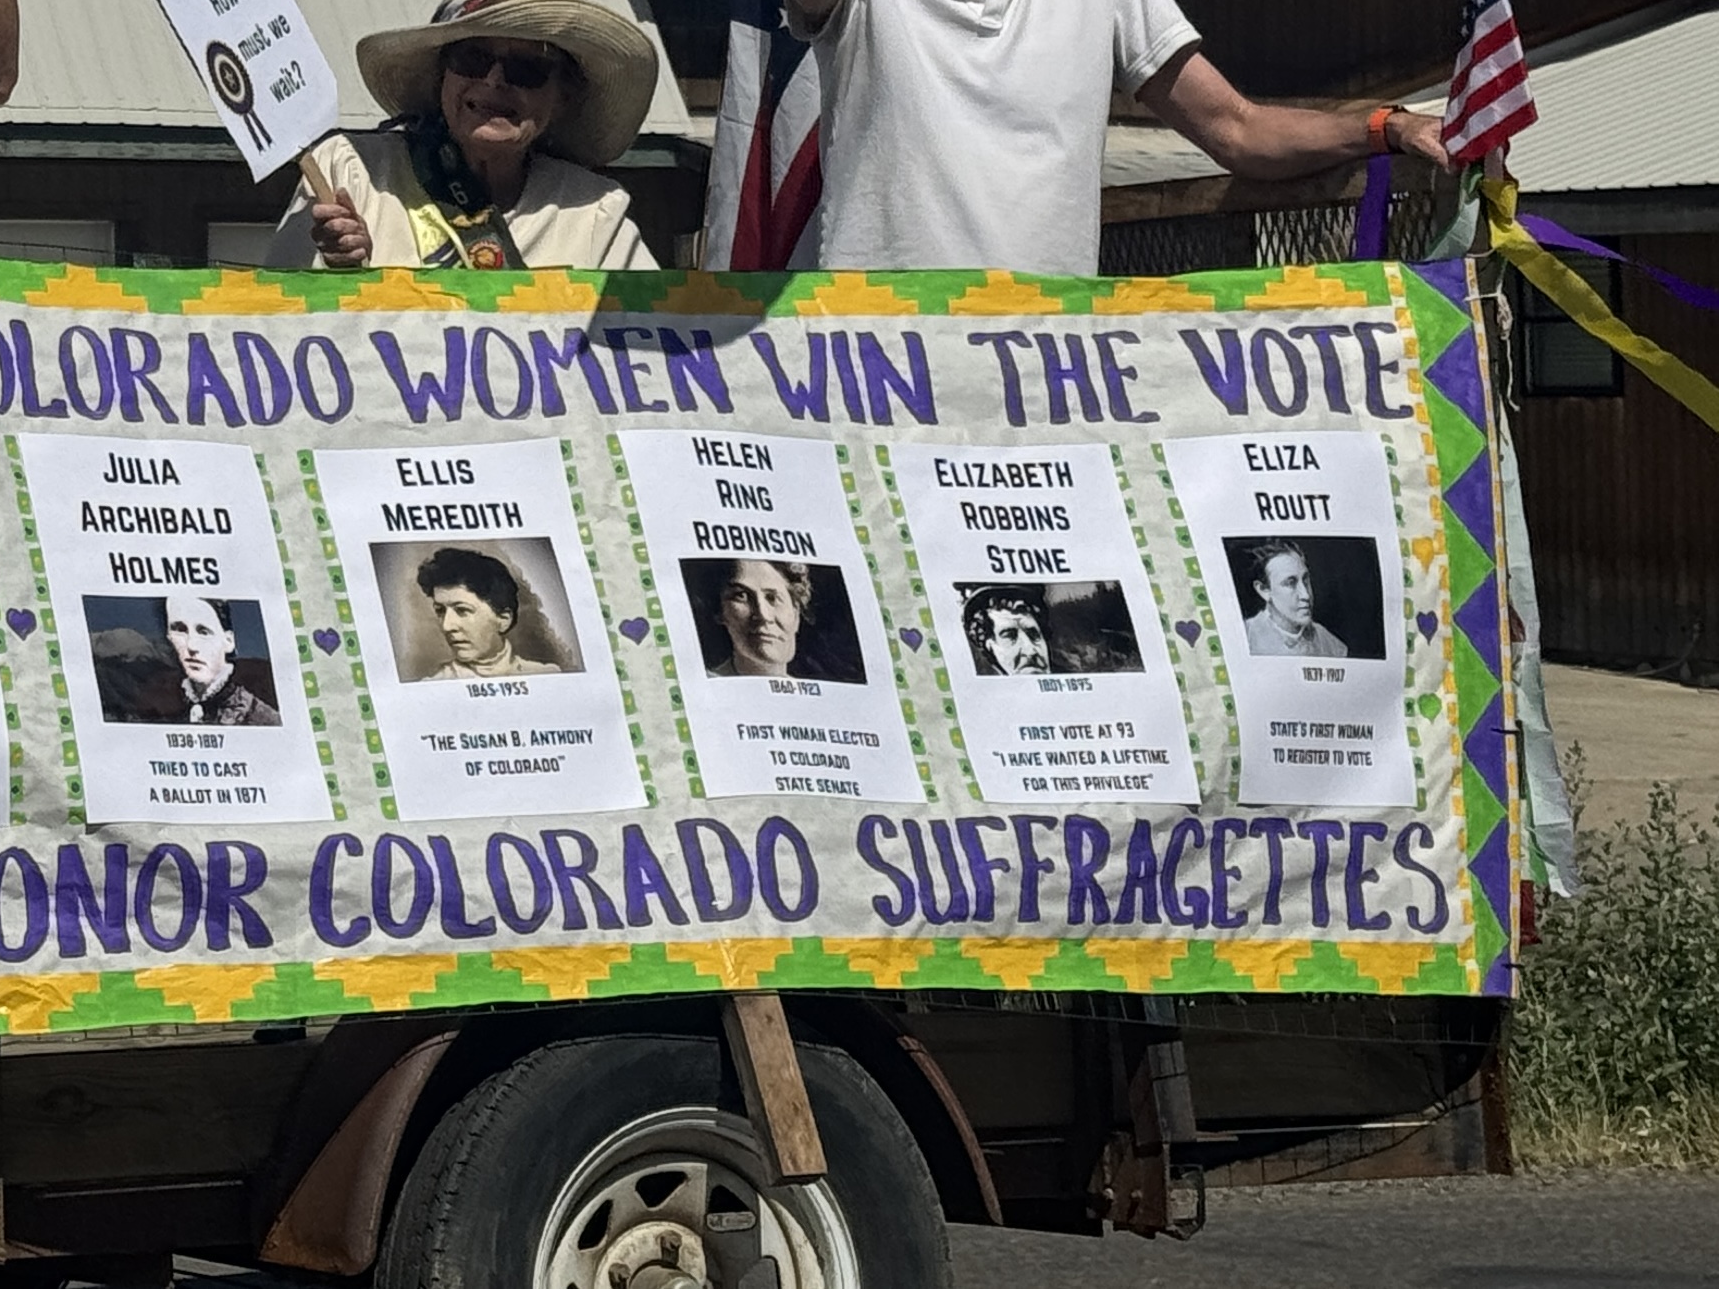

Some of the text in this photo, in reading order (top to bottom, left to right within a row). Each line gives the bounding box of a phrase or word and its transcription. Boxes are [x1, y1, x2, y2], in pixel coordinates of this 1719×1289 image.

[237, 14, 292, 62] must we
[268, 60, 307, 104] wait?
[368, 323, 735, 426] WOMEN
[752, 328, 938, 425] WIN
[967, 328, 1160, 428] THE
[1177, 321, 1414, 425] VOTE
[103, 453, 181, 485] JULIA
[691, 437, 773, 472] HELEN
[1242, 443, 1320, 472] ELIZA
[396, 458, 475, 487] ELLIS
[934, 458, 1073, 488] ELIZABETH
[715, 479, 773, 512] RING
[1254, 492, 1331, 521] ROUTT
[81, 501, 232, 534] ARCHIBALD
[381, 502, 523, 532] MEREDITH
[693, 521, 818, 557] ROBINSON
[109, 553, 220, 585] HOLMES
[986, 545, 1071, 574] STONE
[459, 732, 508, 749] SUSAN
[510, 730, 527, 747] B.
[530, 728, 593, 747] ANTHONY
[737, 724, 880, 747] FIRST WOMAN ELECTED
[1019, 722, 1135, 741] FIRST VOTE AT 93
[1270, 720, 1374, 740] STATE'S FIRST WOMAN
[149, 760, 248, 778] TRIED TO CAST
[465, 761, 484, 777] OF
[769, 750, 850, 770] TO COLORADO
[1007, 751, 1041, 767] HAVE
[1045, 750, 1096, 766] WAITED
[1100, 750, 1111, 765] A
[1113, 749, 1171, 765] LIFETIME
[1273, 748, 1373, 766] TO REGISTER TO VOTE
[149, 787, 267, 804] A BALLOT IN 1871
[775, 776, 863, 797] STATE SENATE
[1023, 776, 1048, 791] FOR
[1051, 776, 1081, 791] THIS
[309, 815, 820, 949] COLORADO
[856, 814, 1450, 934] SUFFRAGETTES
